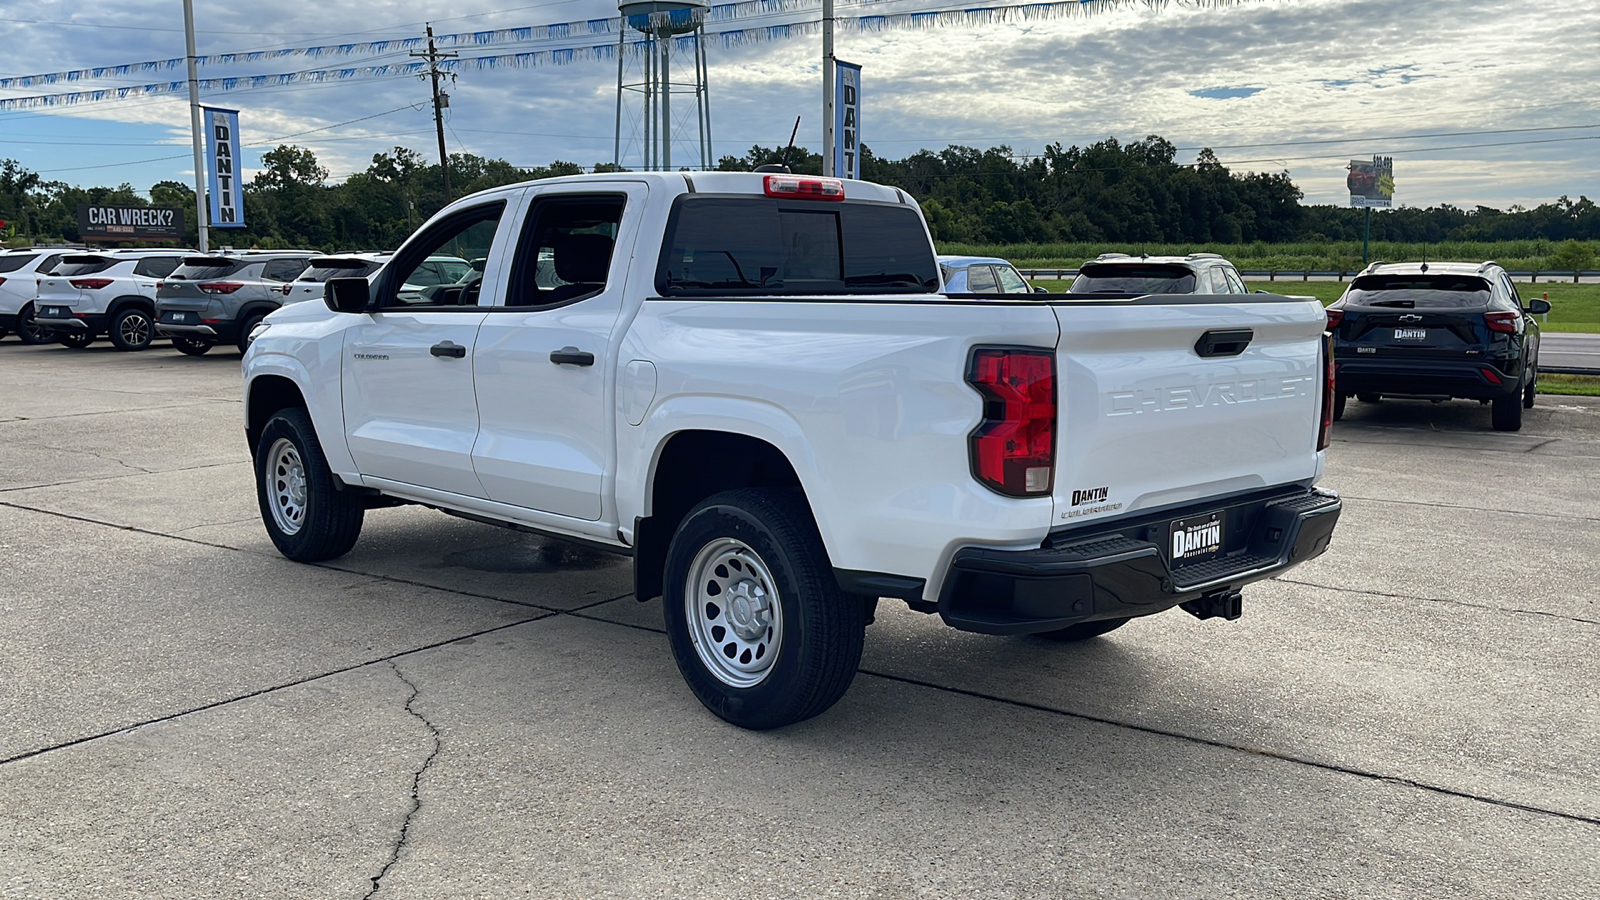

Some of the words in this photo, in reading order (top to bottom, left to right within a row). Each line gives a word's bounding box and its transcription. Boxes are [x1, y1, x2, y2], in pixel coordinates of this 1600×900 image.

[844, 85, 856, 179] DANT
[215, 125, 235, 222] DANTIN
[88, 207, 117, 225] CAR
[119, 208, 174, 226] WRECK?
[1394, 329, 1426, 339] DANTIN
[1106, 374, 1313, 417] CHEVROLET
[1071, 486, 1109, 507] DANTIN
[1173, 525, 1220, 559] DANTIN
